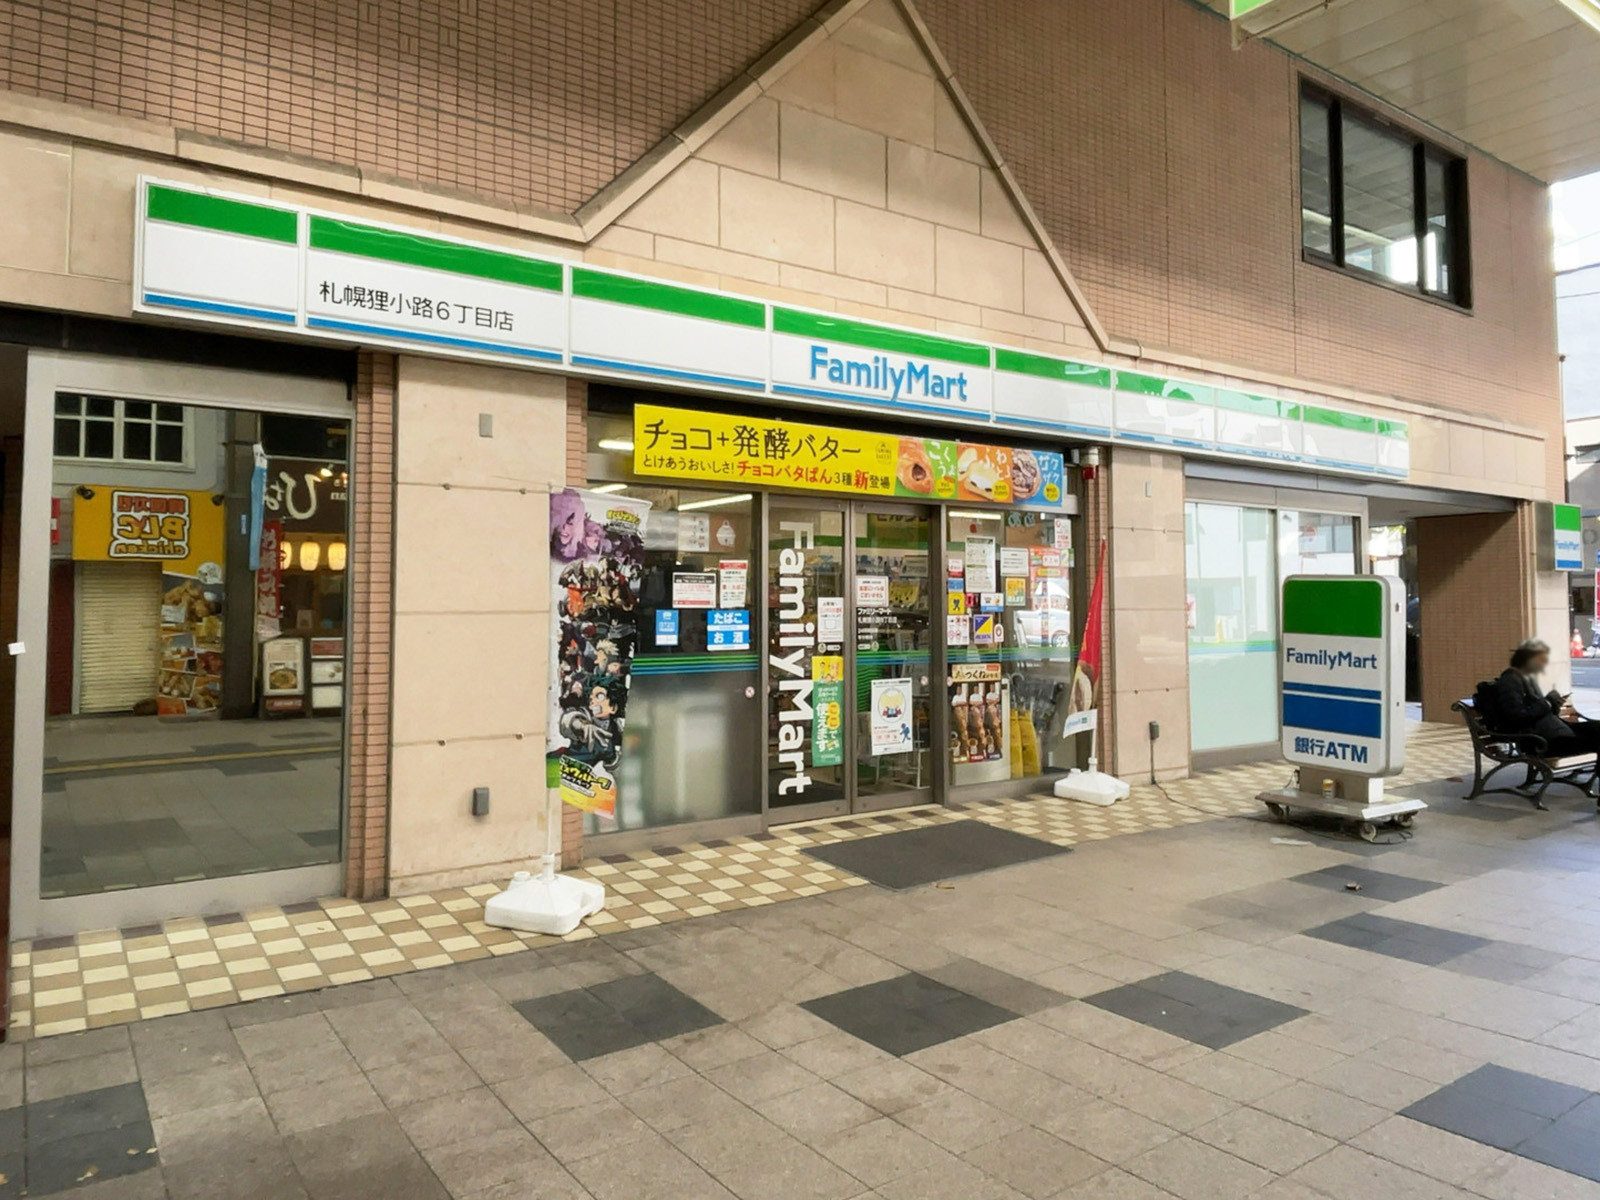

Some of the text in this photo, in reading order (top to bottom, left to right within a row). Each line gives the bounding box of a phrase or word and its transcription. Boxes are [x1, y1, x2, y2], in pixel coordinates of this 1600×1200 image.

[319, 281, 514, 331] 札幌狸小路6丁目店
[810, 345, 967, 401] FamilyMart
[644, 419, 862, 462] チョコ+発酵バター
[643, 454, 735, 474] とけあうおいしさ!
[713, 612, 743, 625] たばこ
[713, 631, 744, 645] お酒
[769, 521, 815, 796] FamilyMart
[1286, 647, 1378, 671] FamilyMart
[1294, 736, 1369, 764] 銀行ATM
